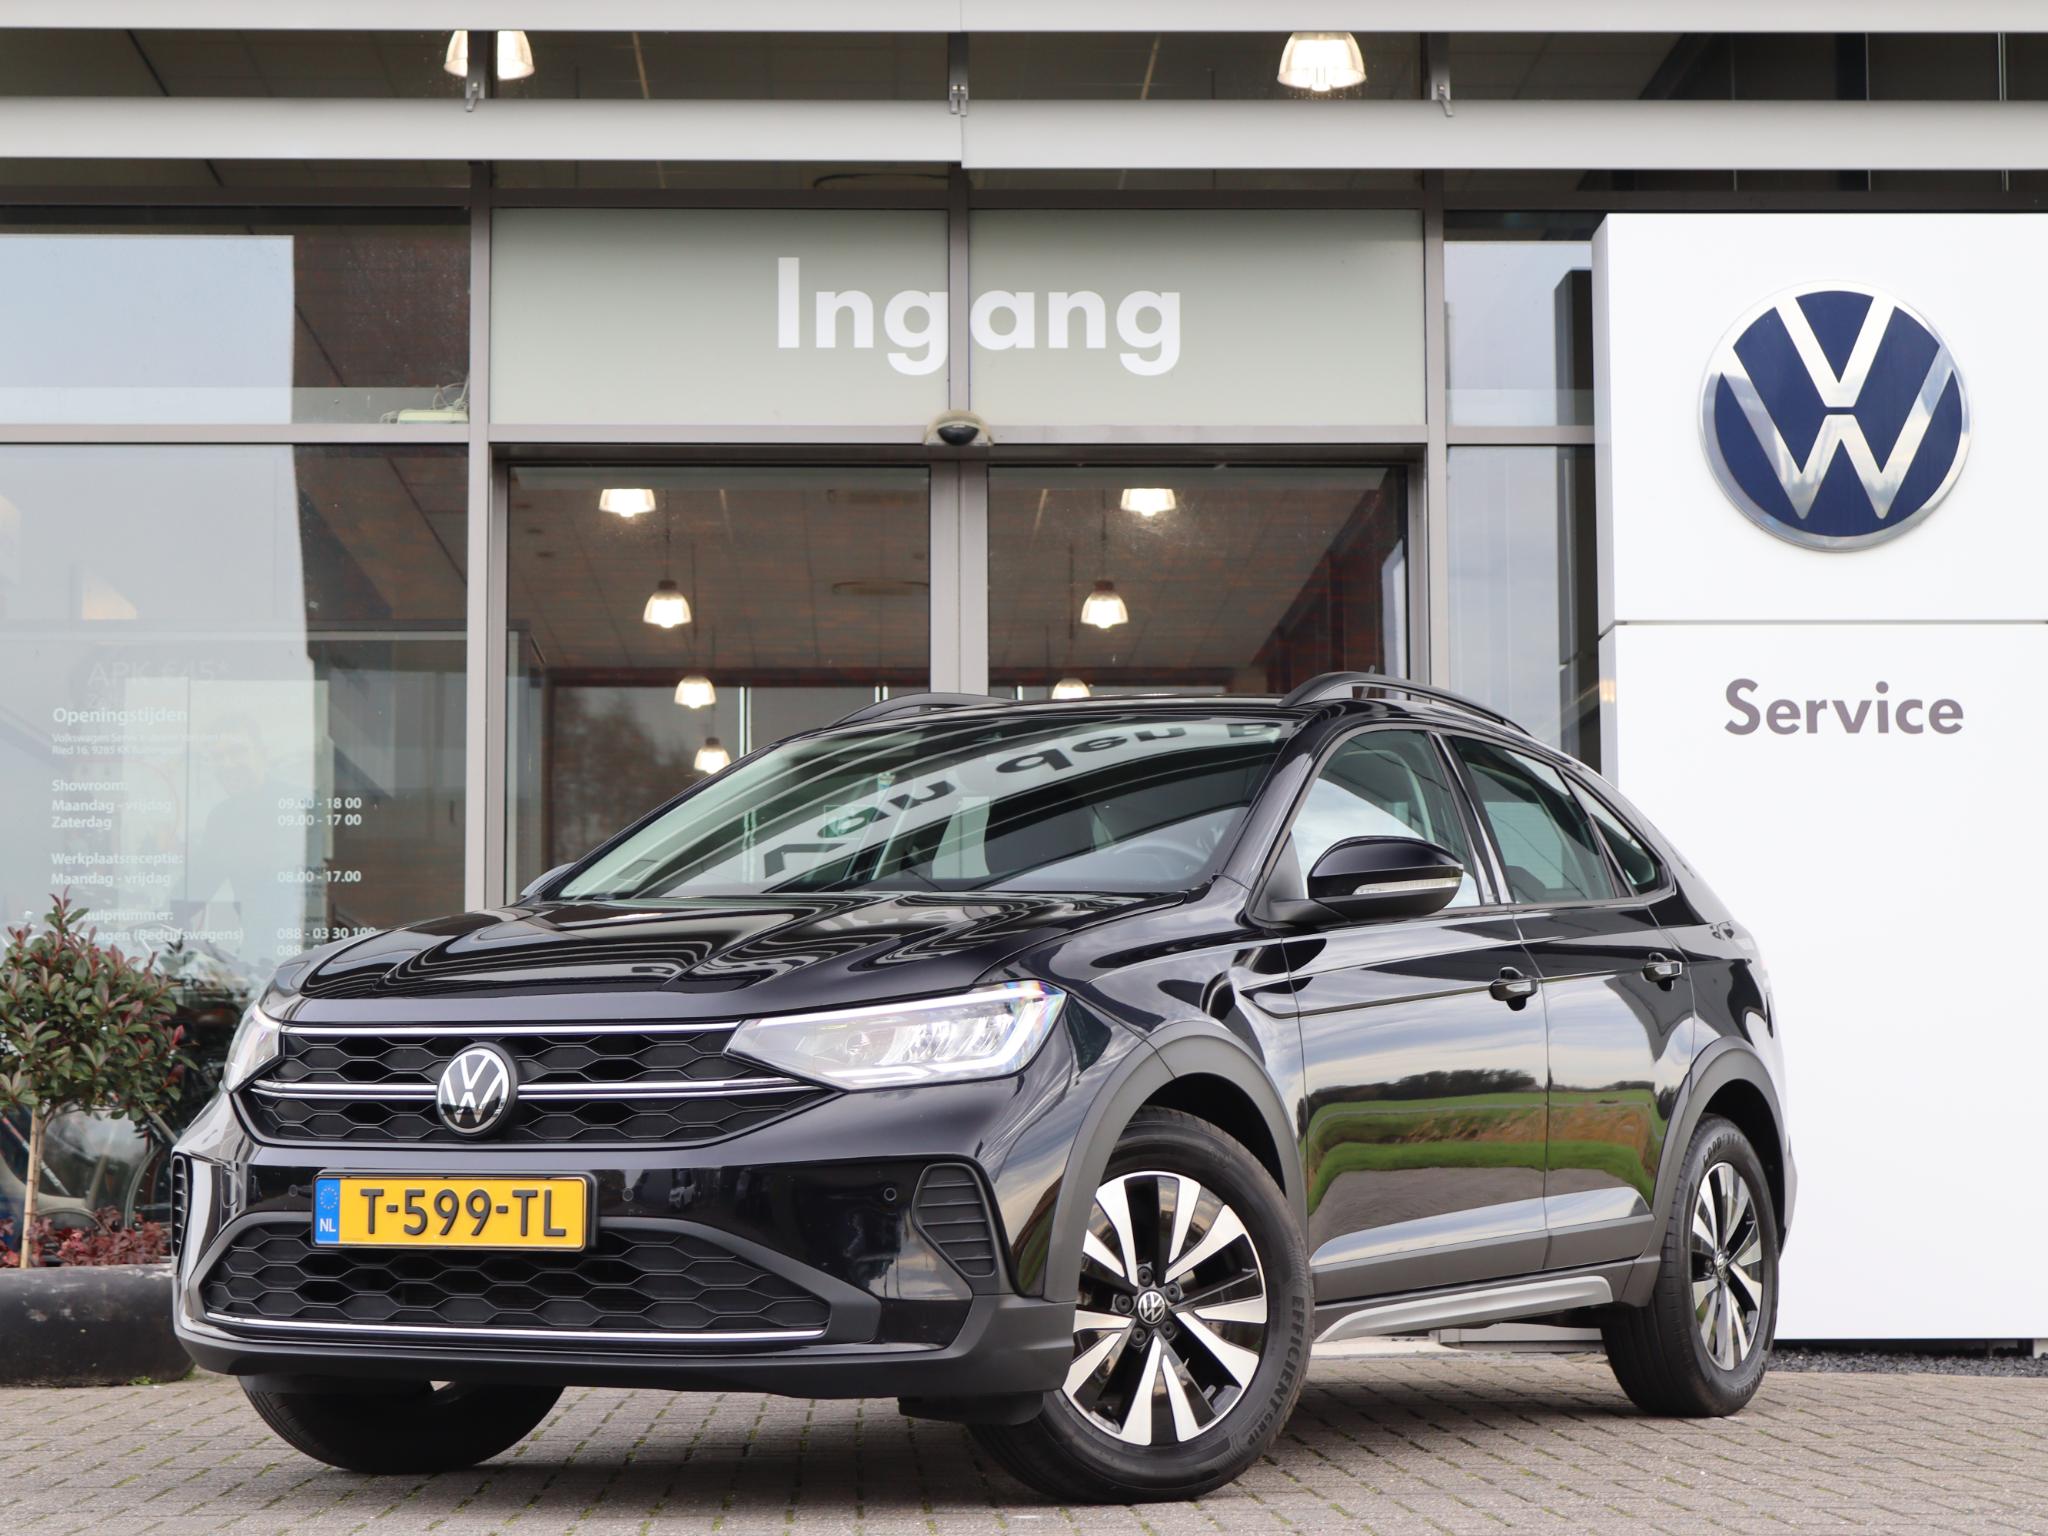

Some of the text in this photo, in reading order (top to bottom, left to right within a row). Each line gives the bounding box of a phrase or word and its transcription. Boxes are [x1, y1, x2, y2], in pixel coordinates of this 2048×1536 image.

[777, 256, 1181, 376] Ingang
[1699, 281, 1972, 551] VW
[1724, 678, 1964, 736] Service
[52, 707, 187, 726] Openingstijden
[51, 799, 115, 815] Maandag
[125, 800, 173, 816] vrijdag
[51, 815, 113, 831] Zaterdag
[277, 814, 315, 827] 09.00
[51, 852, 184, 868] Werkplaatsreceptie:
[50, 872, 114, 888] Maandag
[123, 871, 172, 888] vrijdag
[325, 869, 362, 883] 17.00
[276, 927, 302, 940] 088
[312, 927, 329, 940] 03
[332, 927, 350, 940] 30
[437, 1048, 510, 1133] VW
[360, 1188, 567, 1237] T-599-TL
[319, 1218, 336, 1233] NL
